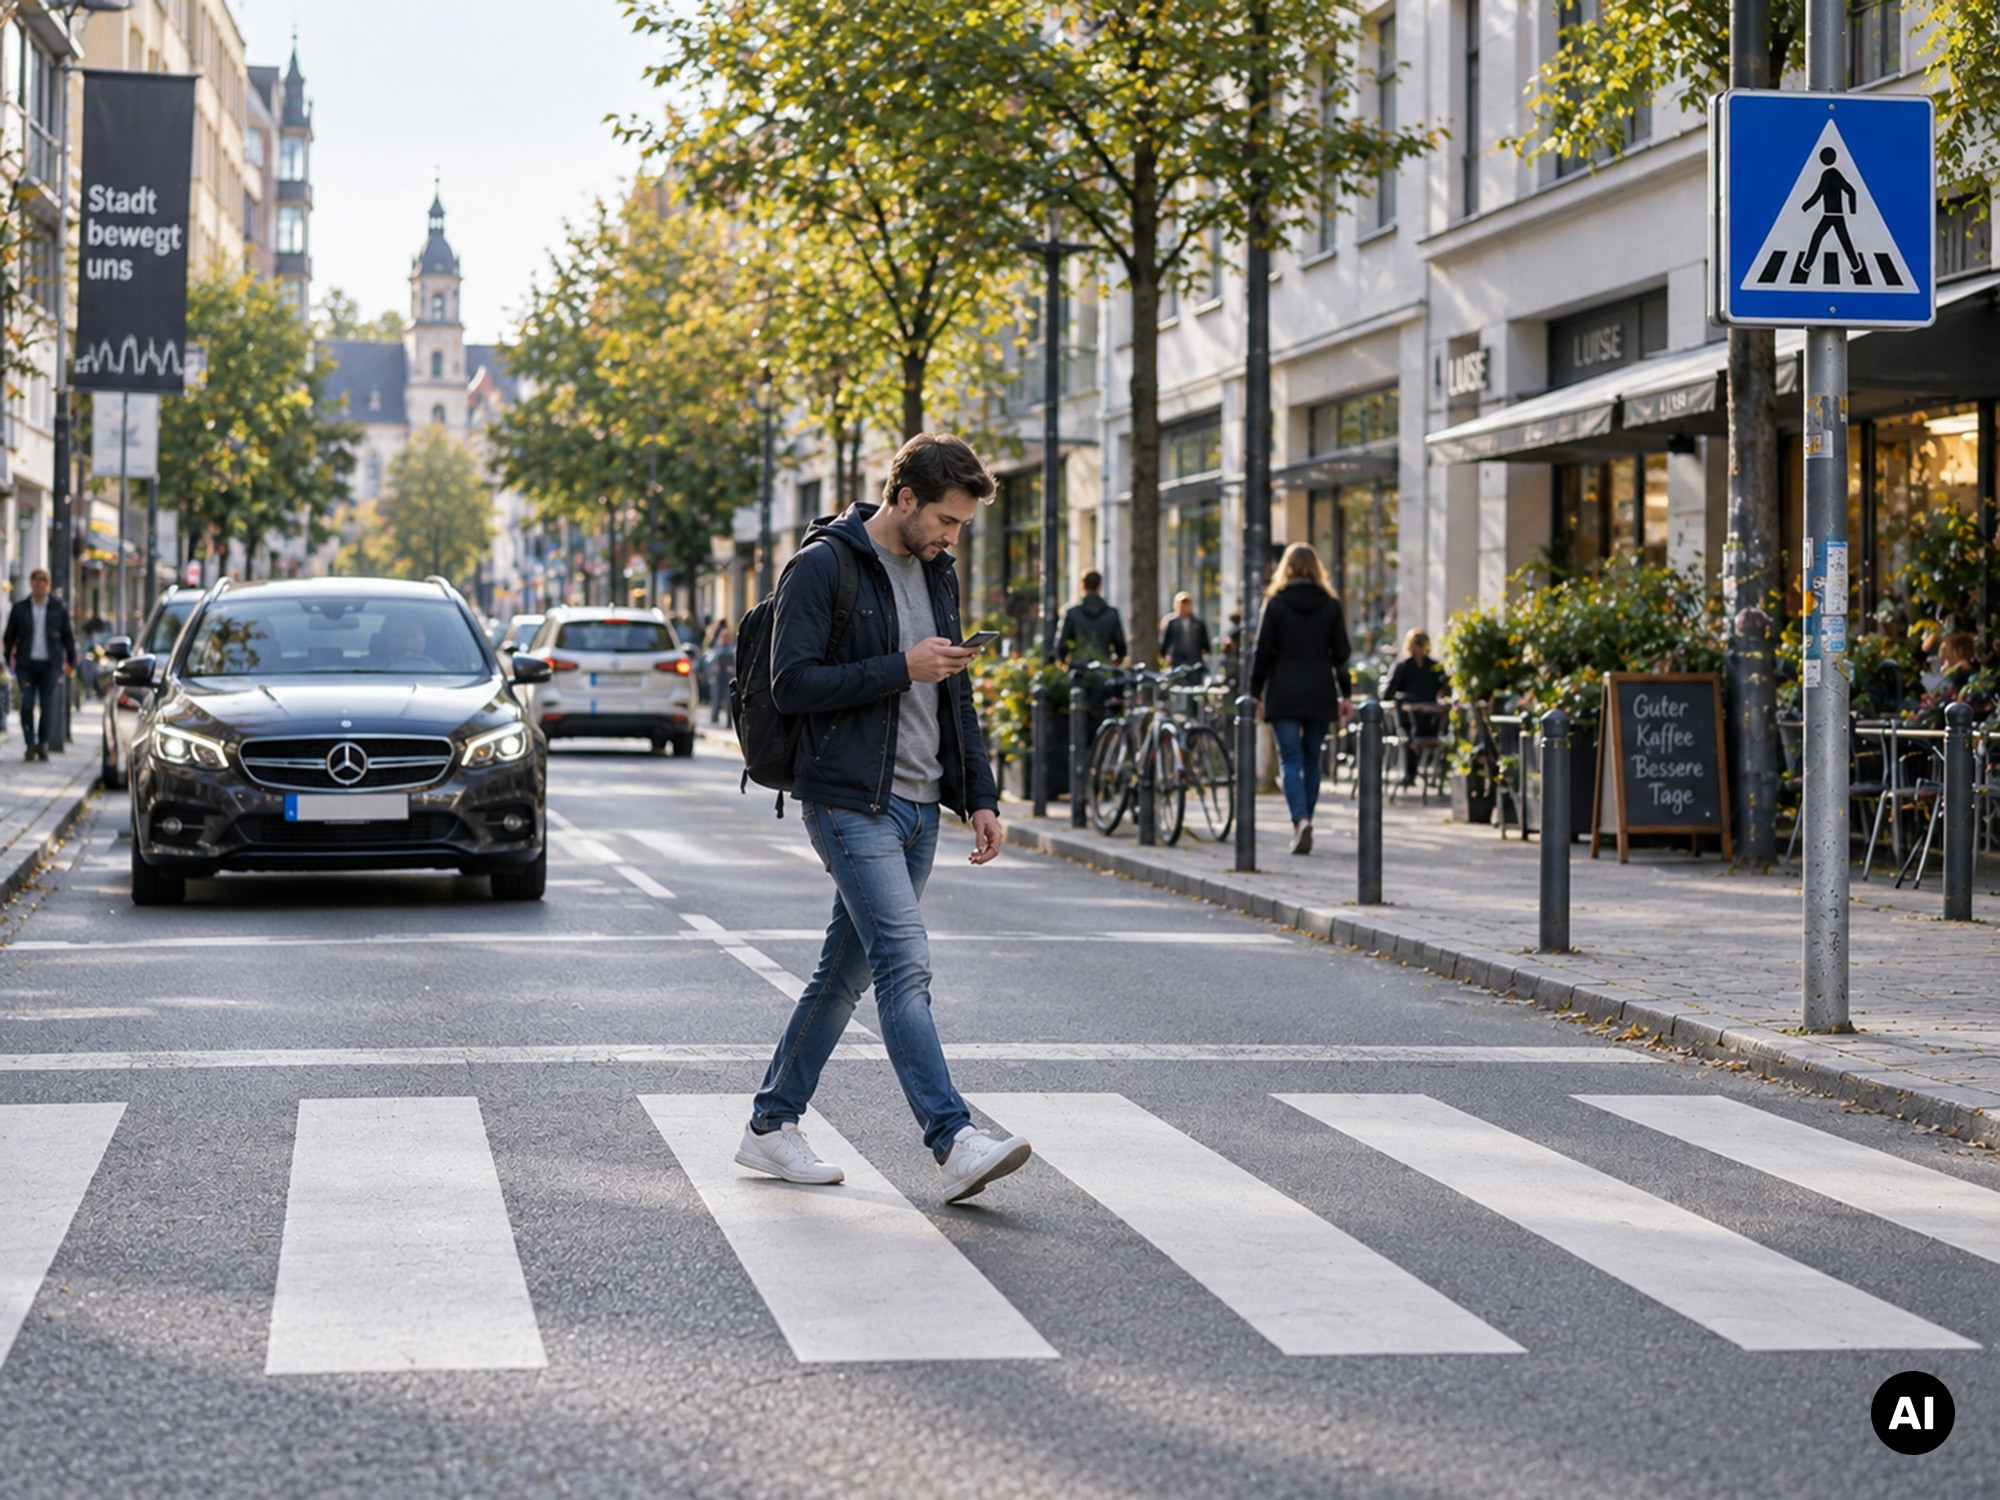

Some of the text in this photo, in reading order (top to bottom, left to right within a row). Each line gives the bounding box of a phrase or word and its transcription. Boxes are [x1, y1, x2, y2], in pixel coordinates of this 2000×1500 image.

[88, 184, 157, 215] Stadt
[87, 218, 182, 257] bewegt
[86, 258, 133, 281] uns
[1573, 324, 1622, 367] LUISE
[1633, 693, 1689, 718] Guter
[1636, 722, 1695, 754] Kaffee
[1631, 754, 1704, 778] Bessere
[1648, 781, 1695, 814] Tage
